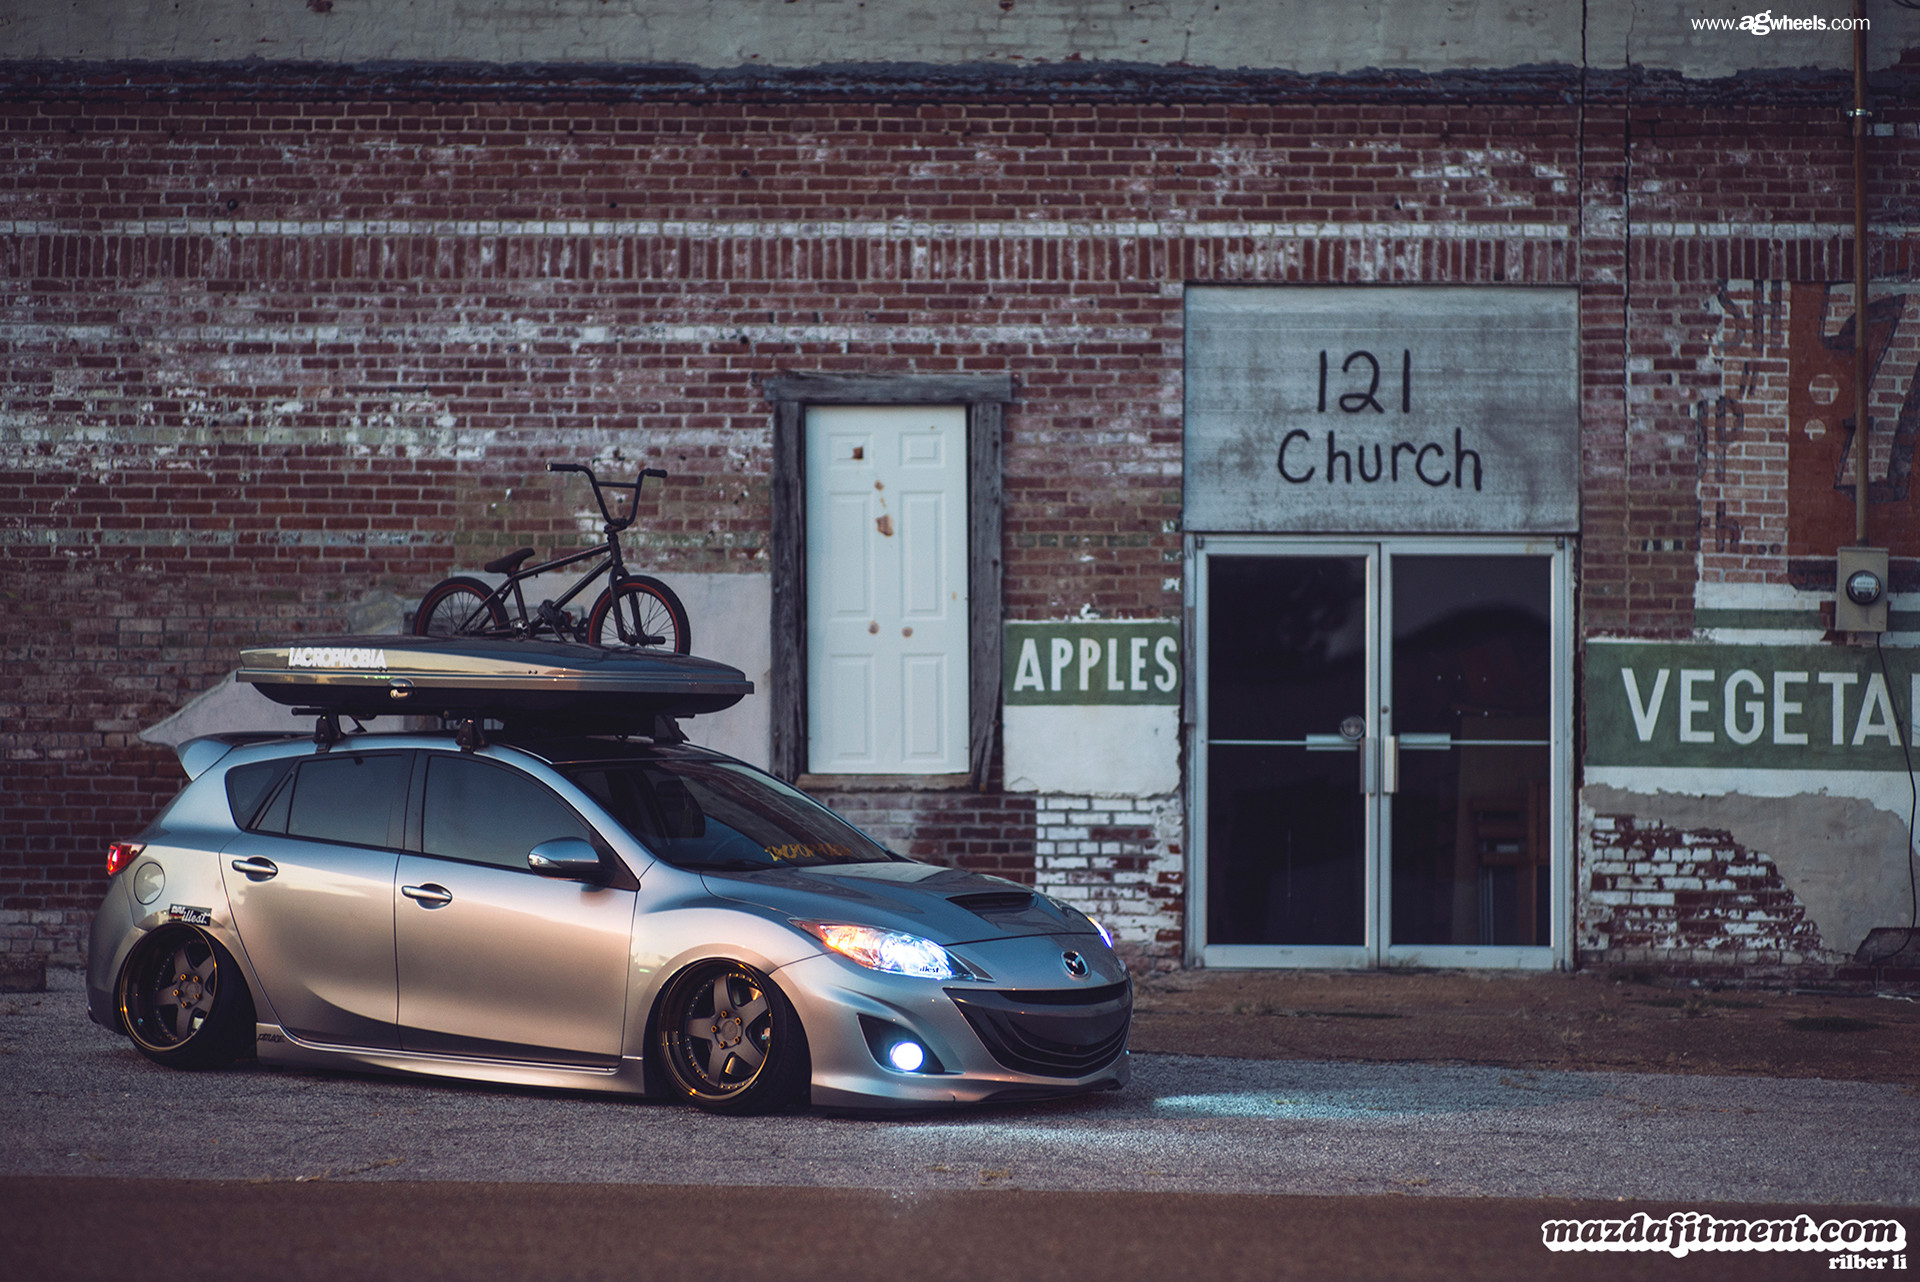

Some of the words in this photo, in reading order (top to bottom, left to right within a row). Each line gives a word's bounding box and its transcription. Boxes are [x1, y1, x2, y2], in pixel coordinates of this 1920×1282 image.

[1317, 349, 1411, 413] 121
[1278, 427, 1482, 491] Church
[1013, 636, 1177, 692] APPLES
